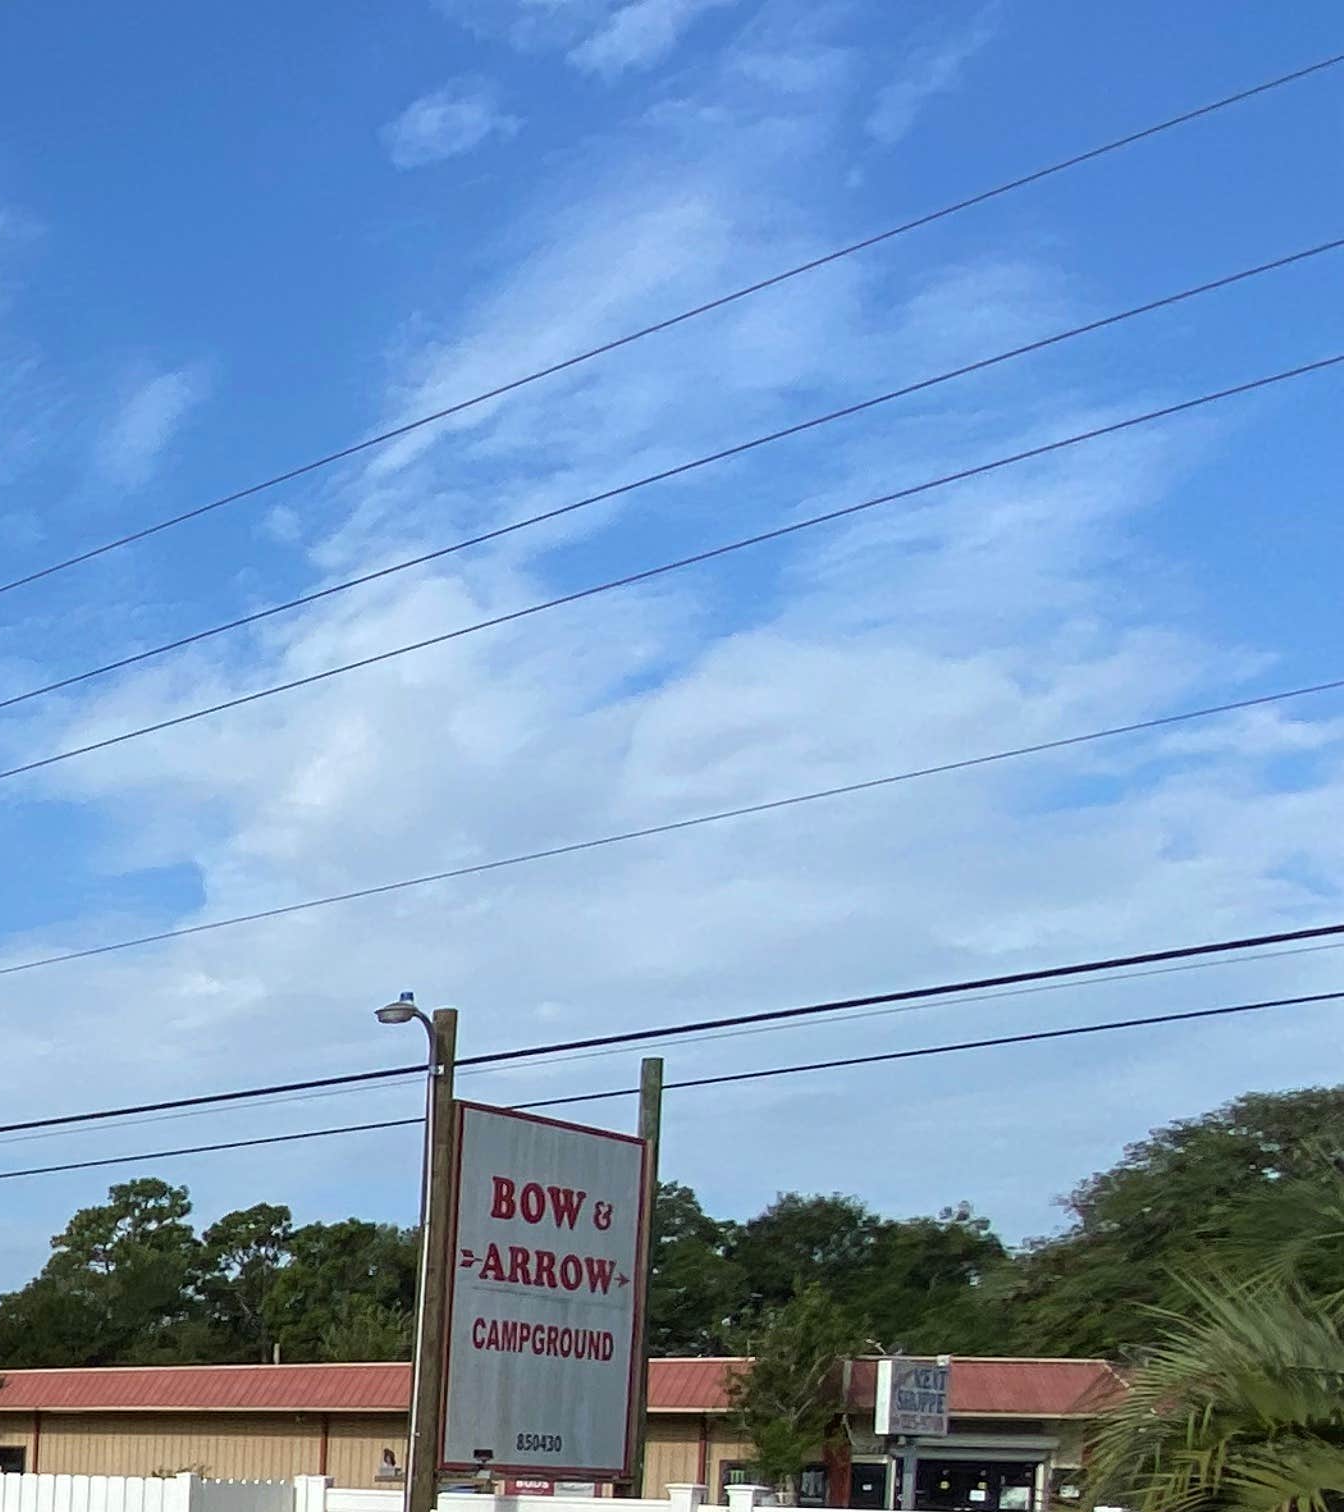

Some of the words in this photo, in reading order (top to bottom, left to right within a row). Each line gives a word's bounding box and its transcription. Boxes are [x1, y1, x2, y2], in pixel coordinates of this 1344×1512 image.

[491, 1175, 587, 1231] BOW
[593, 1200, 613, 1231] &
[479, 1242, 616, 1295] ARROW
[472, 1317, 614, 1362] CAMPGROUND
[516, 1433, 562, 1452] 850430
